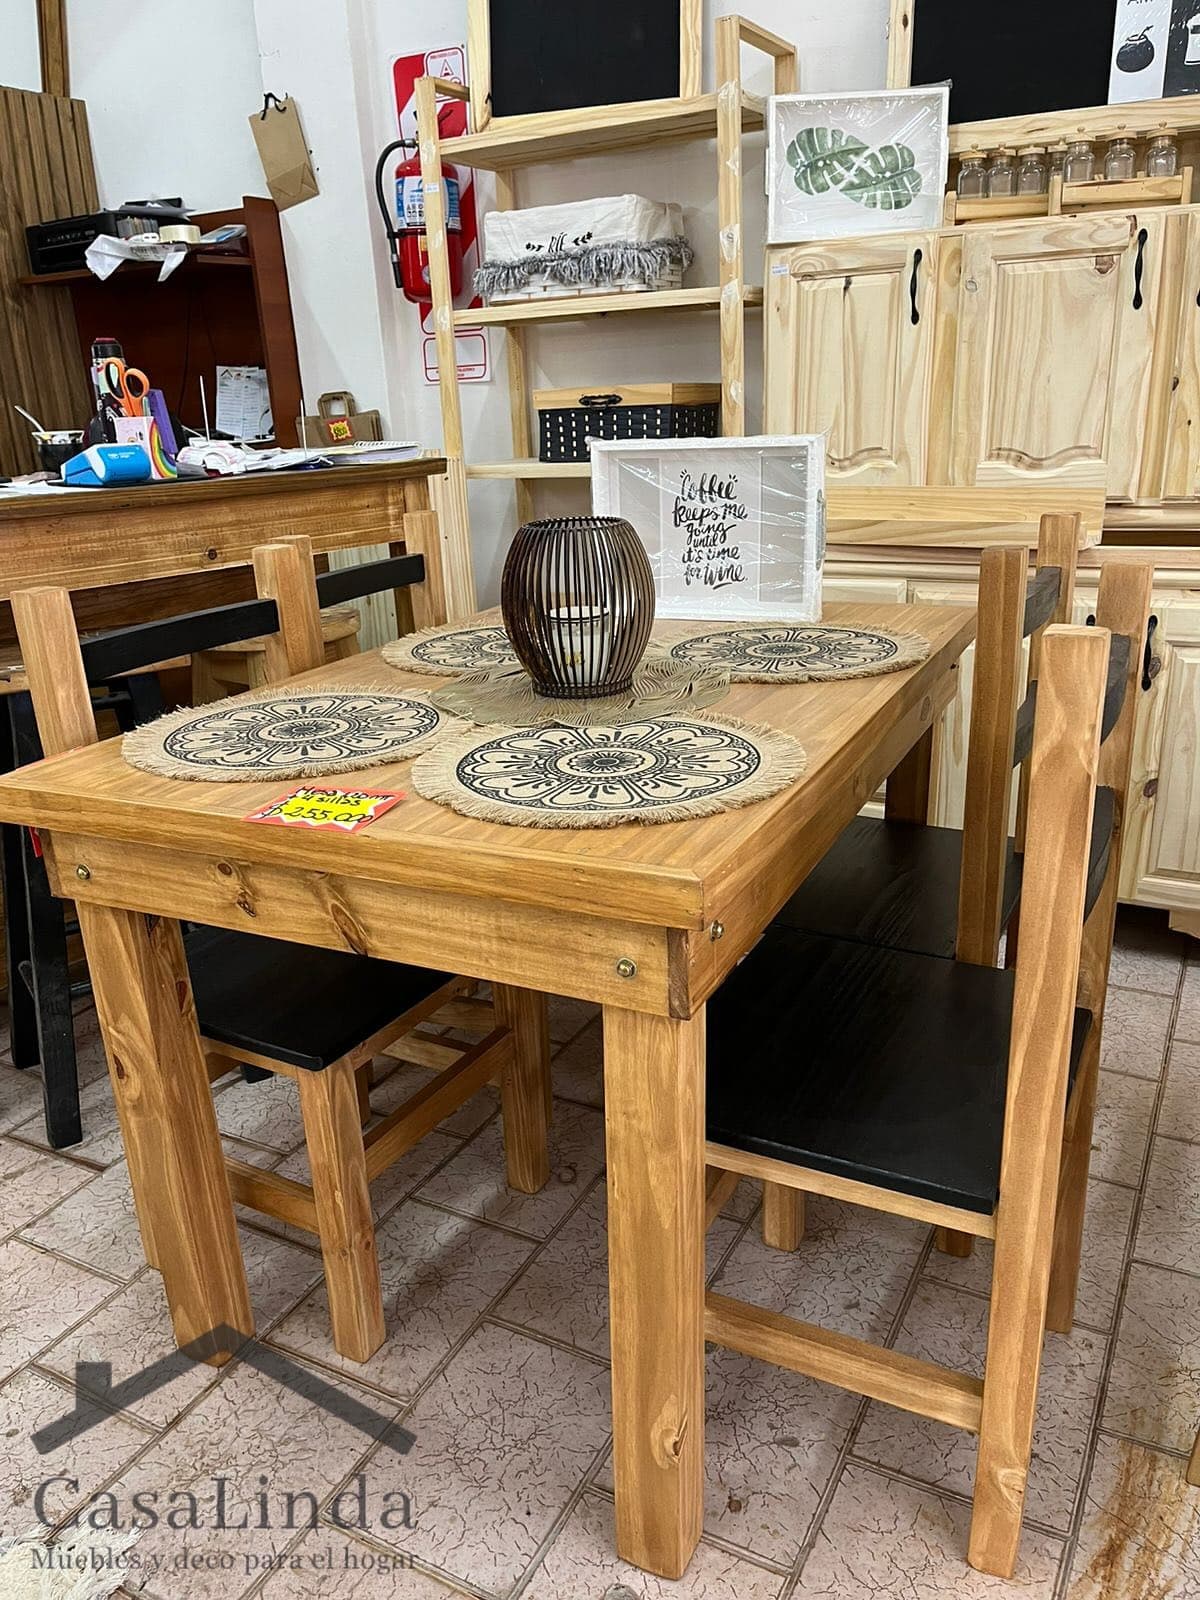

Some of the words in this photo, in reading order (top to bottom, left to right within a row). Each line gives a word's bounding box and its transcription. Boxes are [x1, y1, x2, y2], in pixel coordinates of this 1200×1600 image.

[440, 59, 454, 77] A
[672, 495, 720, 527] keeps
[684, 522, 737, 545] going
[692, 532, 719, 548] until
[682, 547, 703, 563] it's
[684, 564, 702, 586] for
